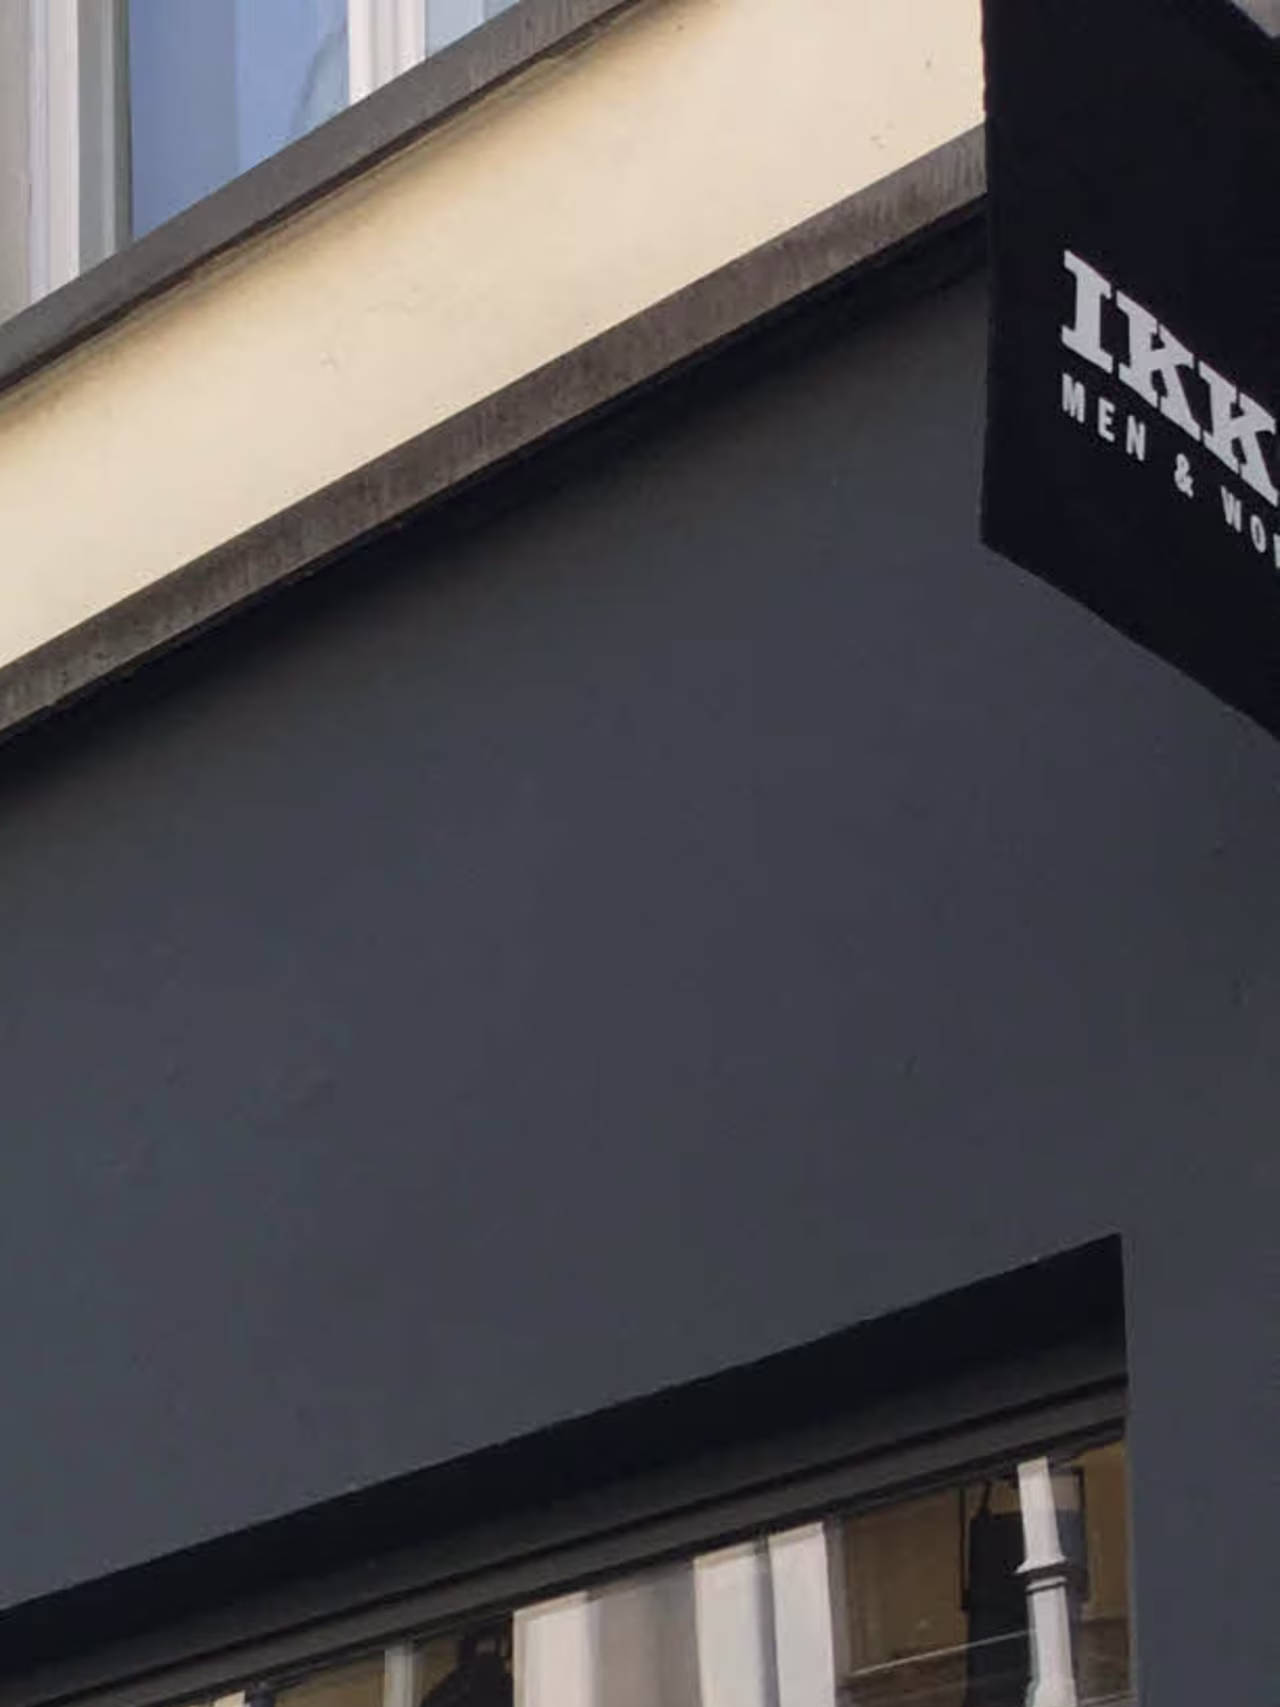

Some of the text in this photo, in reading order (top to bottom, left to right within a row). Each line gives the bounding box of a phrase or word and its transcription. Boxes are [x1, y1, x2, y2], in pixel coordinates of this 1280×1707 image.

[1061, 372, 1280, 569] MEN & WO
